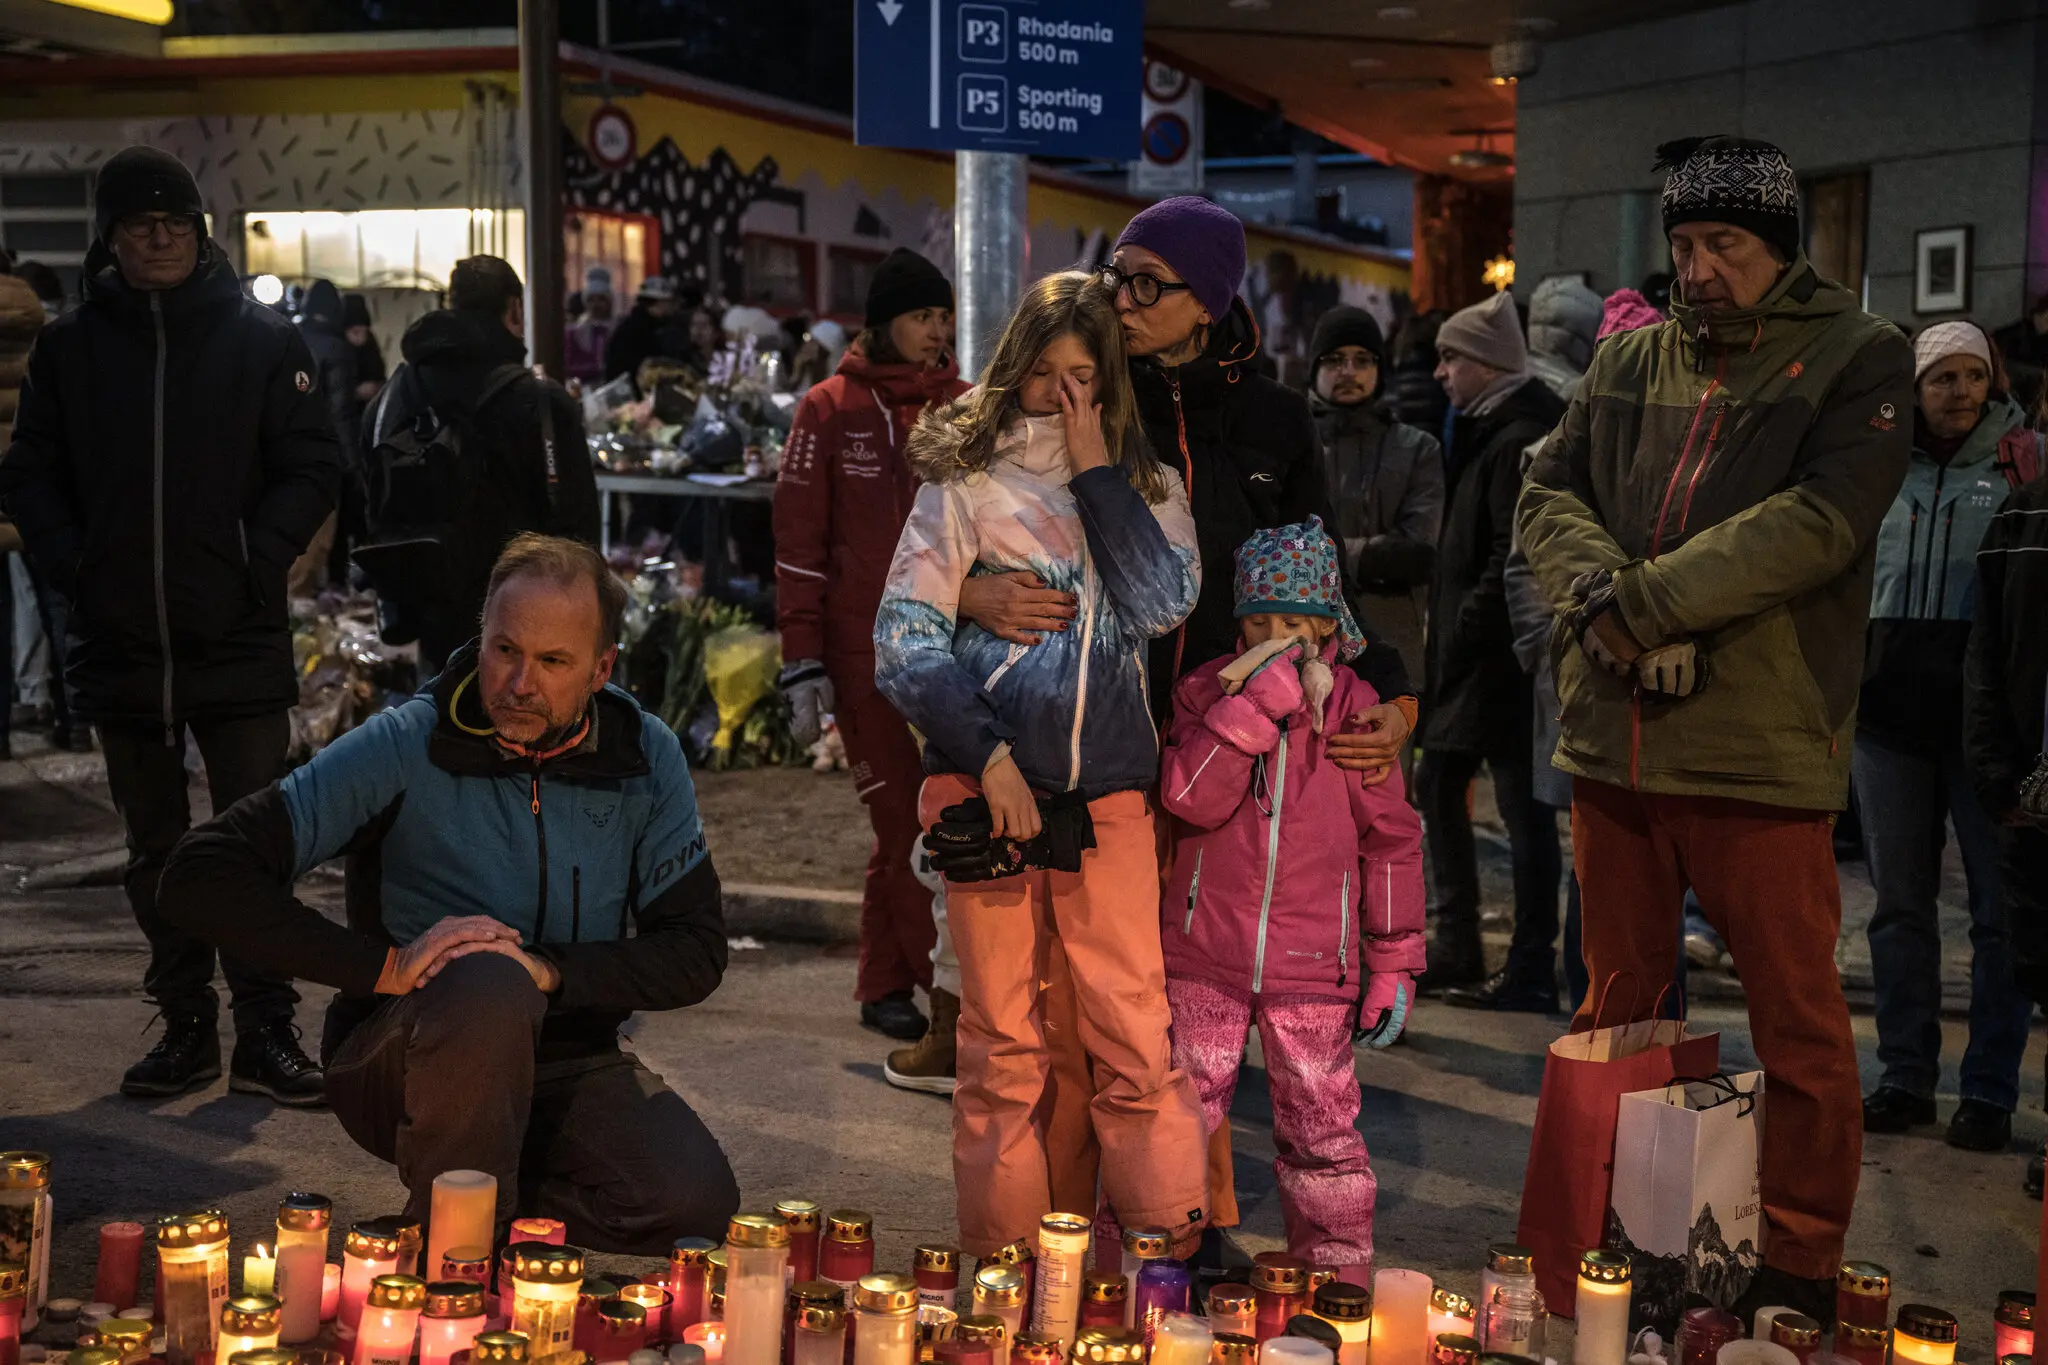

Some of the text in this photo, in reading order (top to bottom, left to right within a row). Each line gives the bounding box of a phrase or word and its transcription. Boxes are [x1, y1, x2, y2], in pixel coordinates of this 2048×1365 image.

[966, 19, 1000, 46] P3
[1017, 16, 1114, 43] Rhodania
[1018, 43, 1056, 62] 500
[966, 88, 1000, 115] P5
[1017, 85, 1102, 115] Sporting
[1018, 111, 1056, 130] 500
[919, 1292, 945, 1302] MIGROS
